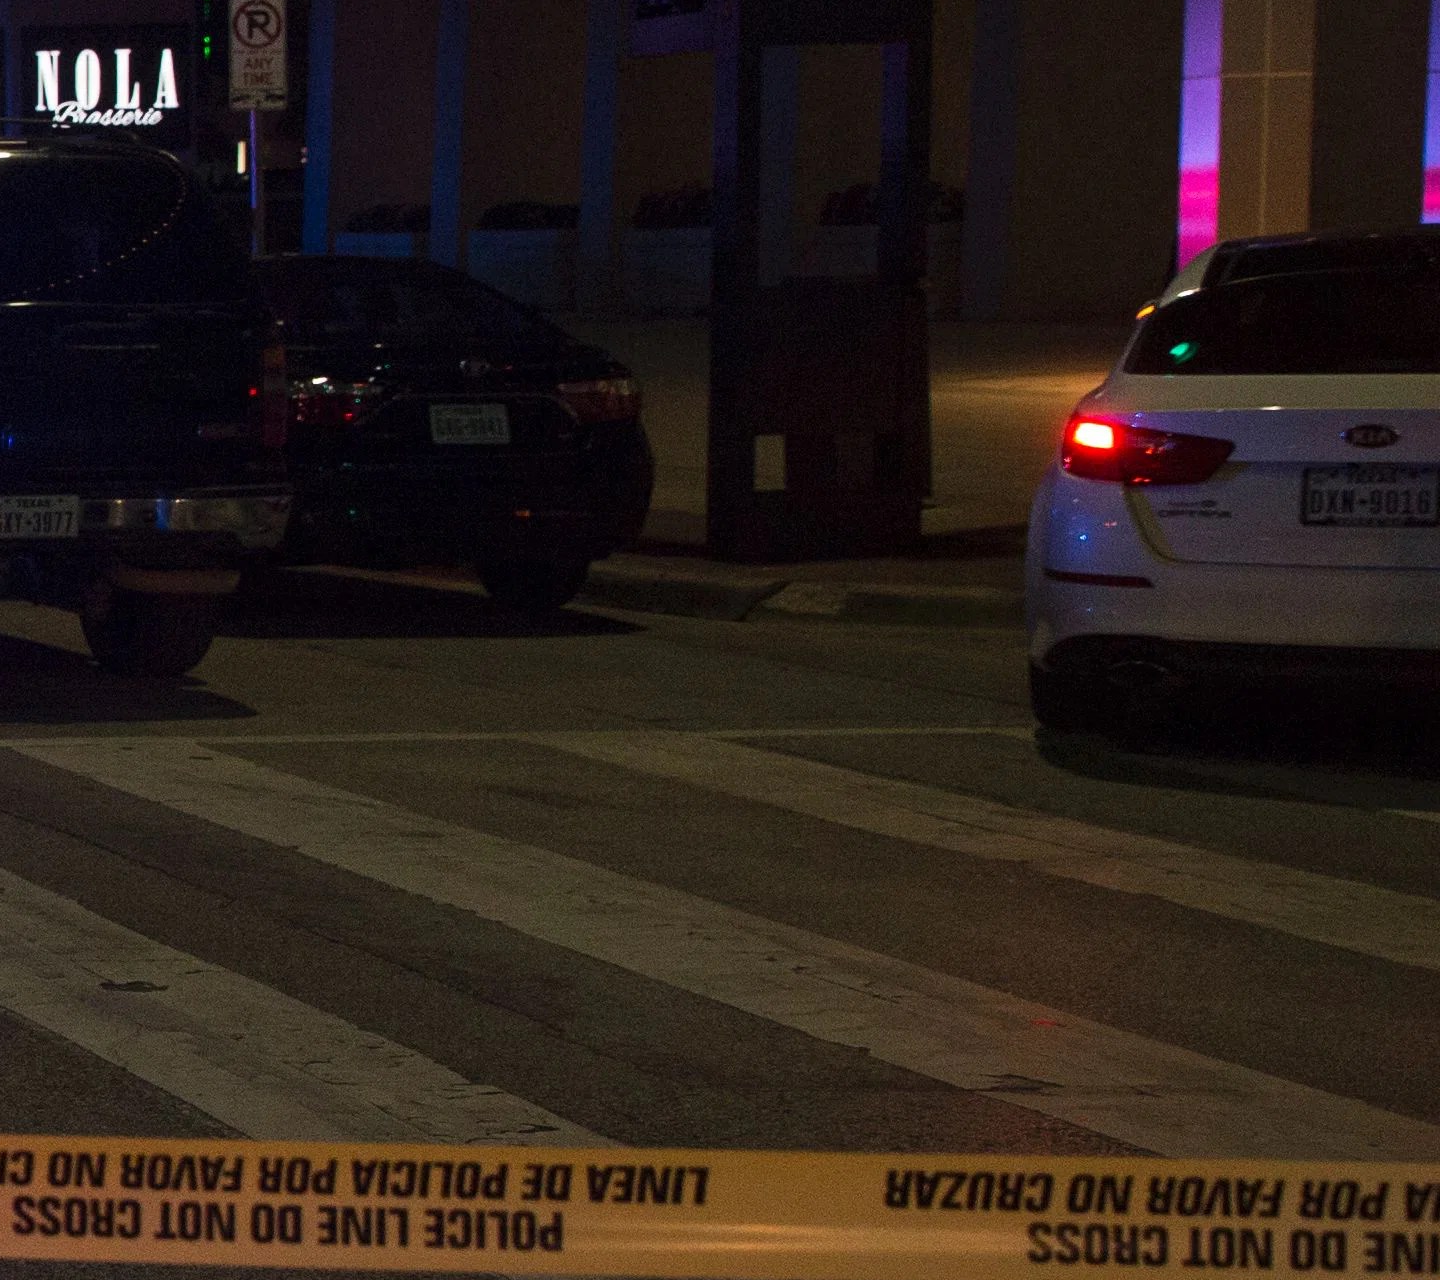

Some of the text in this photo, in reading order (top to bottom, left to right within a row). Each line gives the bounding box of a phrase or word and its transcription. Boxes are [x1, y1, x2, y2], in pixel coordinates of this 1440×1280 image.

[35, 48, 179, 111] NOLA
[243, 72, 273, 87] TIME
[244, 58, 273, 70] ANY
[52, 101, 163, 128] Brasserie
[47, 1151, 106, 1187] NO
[120, 1153, 245, 1191] FAVOR
[257, 1157, 338, 1194] POR
[353, 1159, 509, 1198] POLICIA
[521, 1163, 571, 1201] DE
[585, 1165, 711, 1205] LINEA
[884, 1169, 1056, 1211] CRUZAR
[1067, 1173, 1134, 1214] NO
[1147, 1176, 1286, 1218] FAVOR
[1297, 1179, 1390, 1220] POR
[11, 1194, 565, 1251] POLICE LINE DO NOT CROSS
[1027, 1222, 1168, 1266] CROSS
[1183, 1226, 1274, 1270] NOT
[1290, 1229, 1347, 1271] DO
